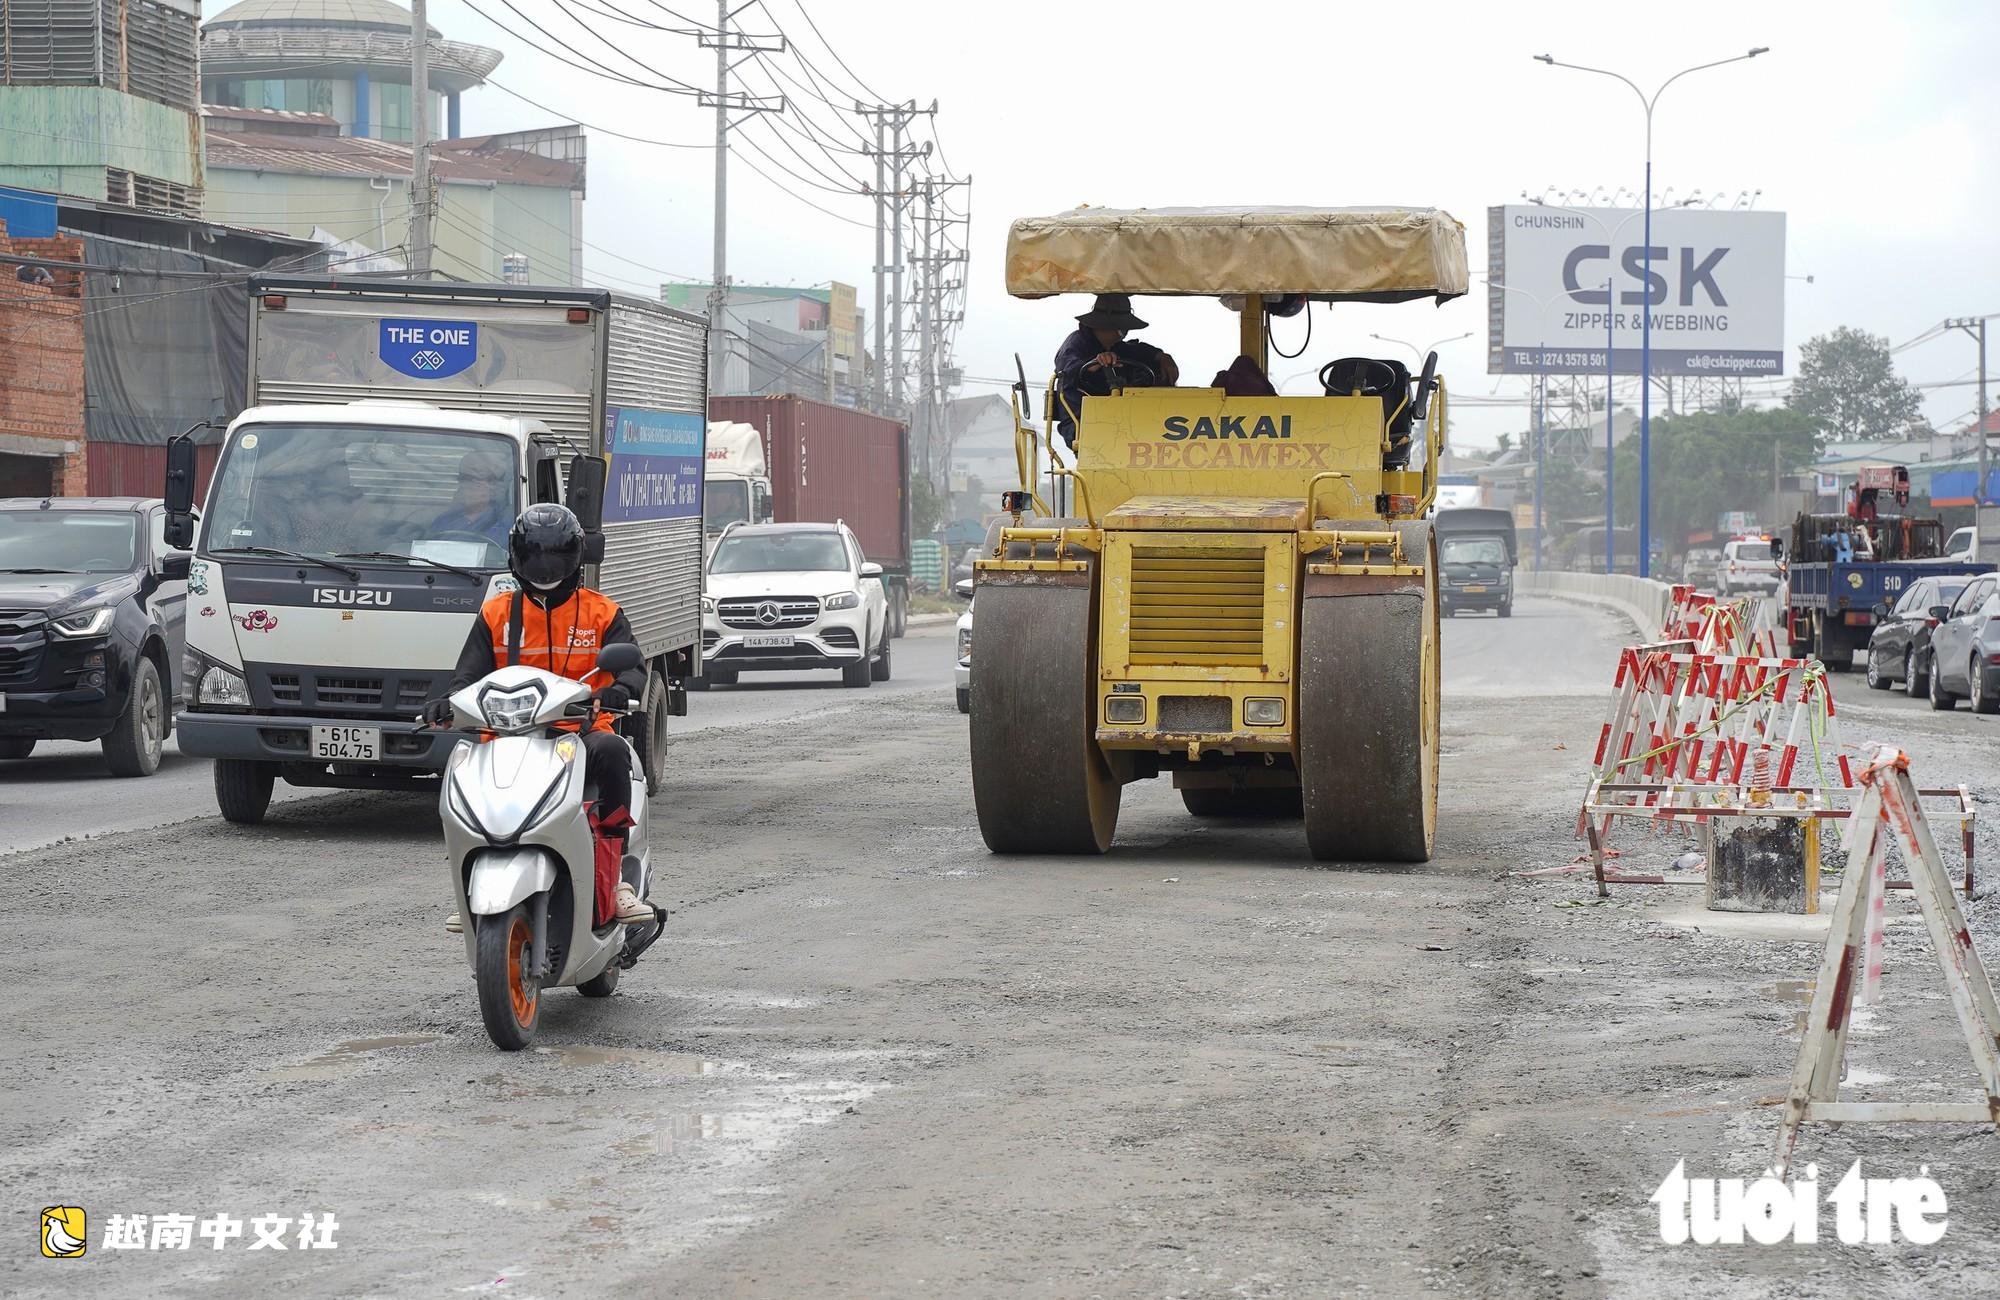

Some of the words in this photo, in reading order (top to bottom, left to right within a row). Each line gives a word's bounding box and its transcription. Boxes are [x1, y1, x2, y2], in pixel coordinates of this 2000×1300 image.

[1514, 215, 1585, 229] CHUNSHIN
[1562, 244, 1731, 307] CSK
[1563, 313, 1626, 330] ZIPPER
[1631, 314, 1643, 330] &
[1648, 314, 1728, 331] WEBBING
[387, 327, 425, 343] THE
[430, 329, 470, 345] ONE
[1513, 352, 1533, 365] TEL
[1565, 353, 1588, 366] 3578
[1590, 353, 1606, 366] 501
[1686, 355, 1777, 371] csk@cskzipper.com
[1162, 415, 1292, 441] SAKAI
[1126, 442, 1330, 469] BECAMEX
[620, 463, 634, 516] NỘI
[651, 473, 663, 505] THE
[663, 473, 676, 505] ONE
[1884, 576, 1901, 590] 51D
[313, 589, 392, 605] ISUZU
[433, 597, 474, 605] QKR
[567, 635, 596, 647] Food
[331, 728, 361, 742] 61C
[319, 743, 373, 758] 504.75
